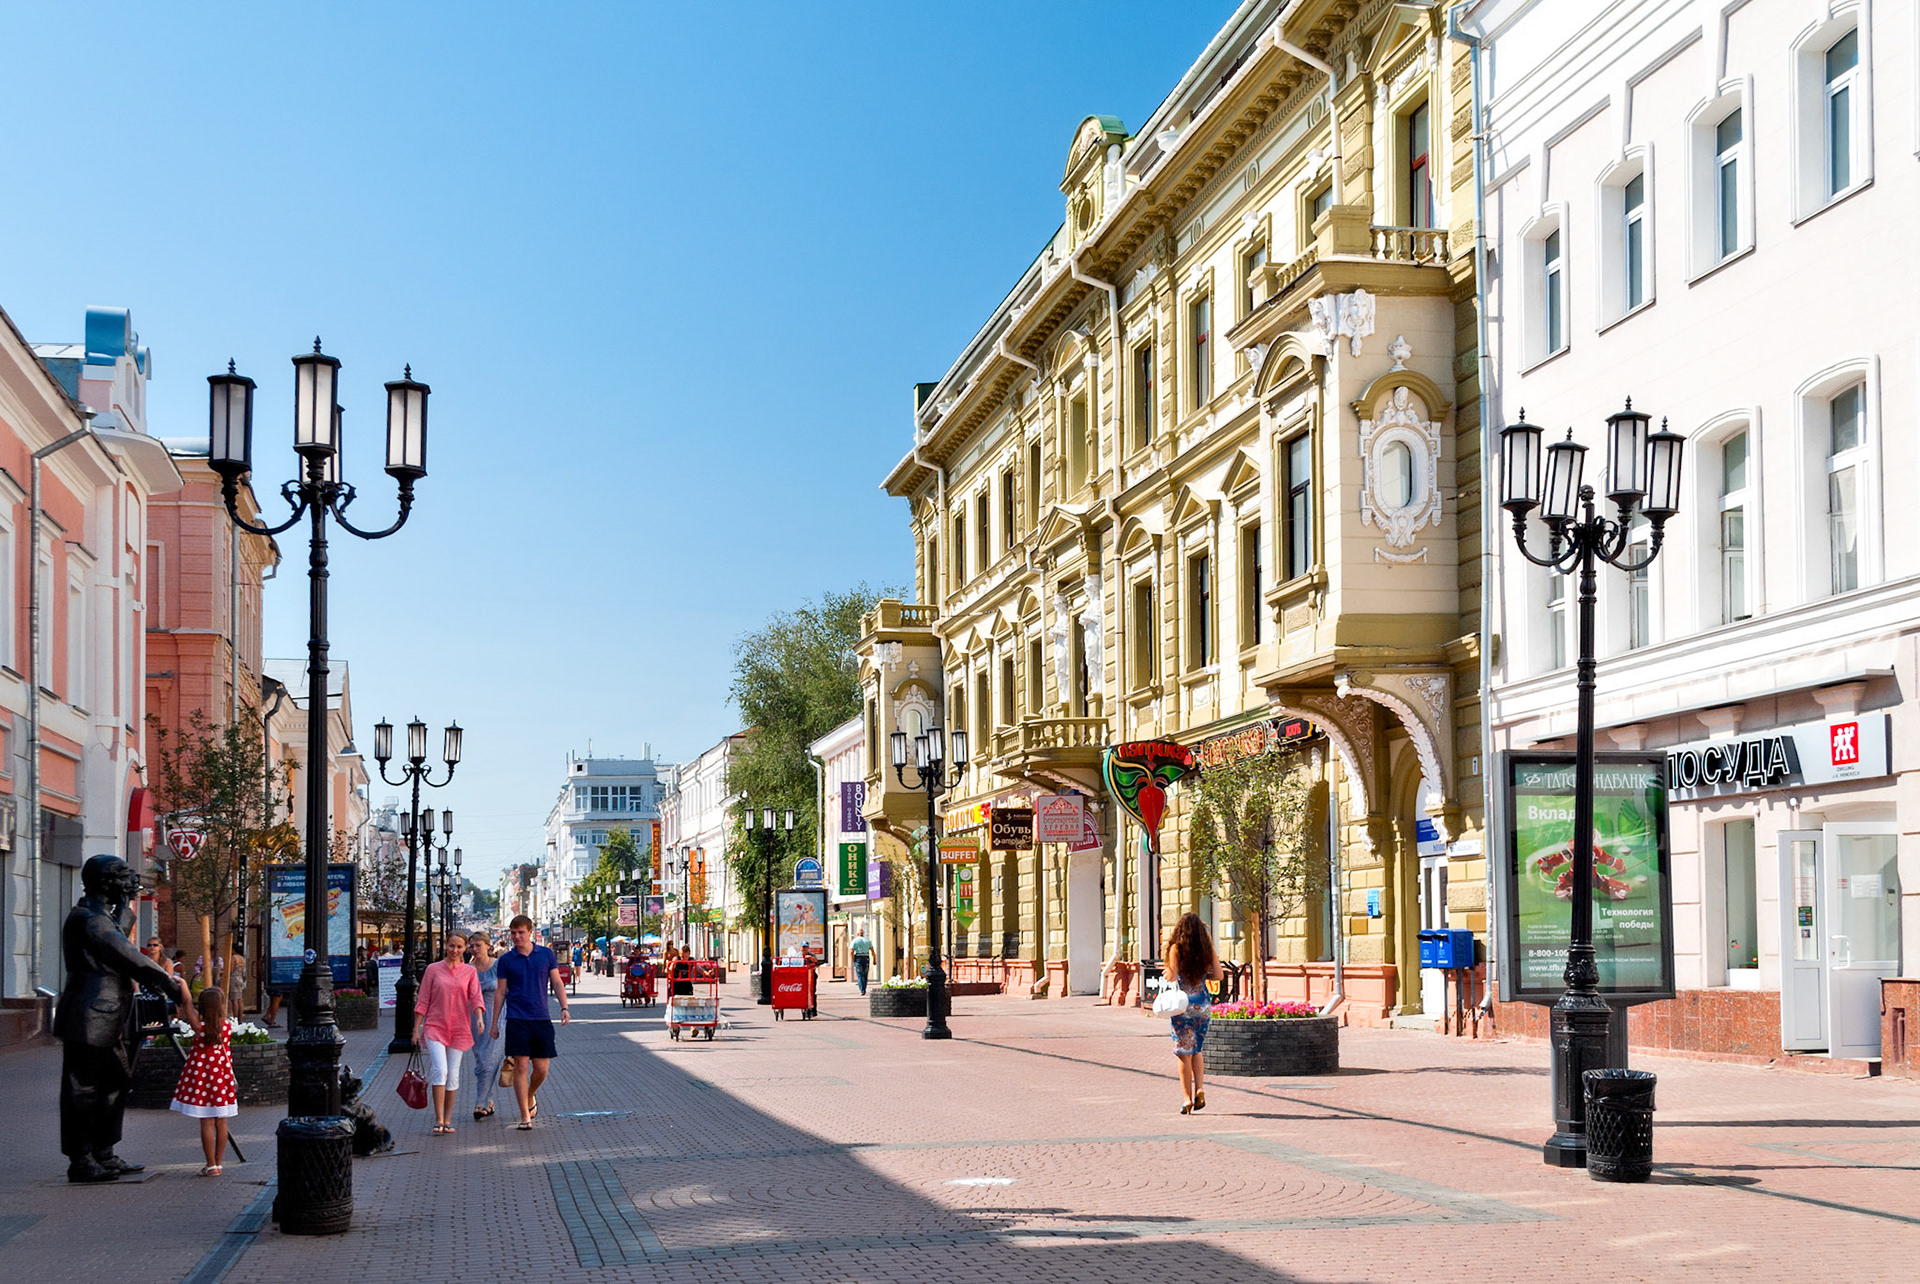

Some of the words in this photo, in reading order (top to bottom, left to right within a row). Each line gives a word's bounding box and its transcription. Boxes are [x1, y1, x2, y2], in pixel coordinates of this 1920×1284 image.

[854, 784, 864, 830] BOUNTY
[992, 823, 1031, 837] Обувь
[940, 849, 977, 860] BUFFET
[847, 844, 858, 888] ОНИКС
[1600, 907, 1653, 917] Технология
[1619, 920, 1654, 930] победы
